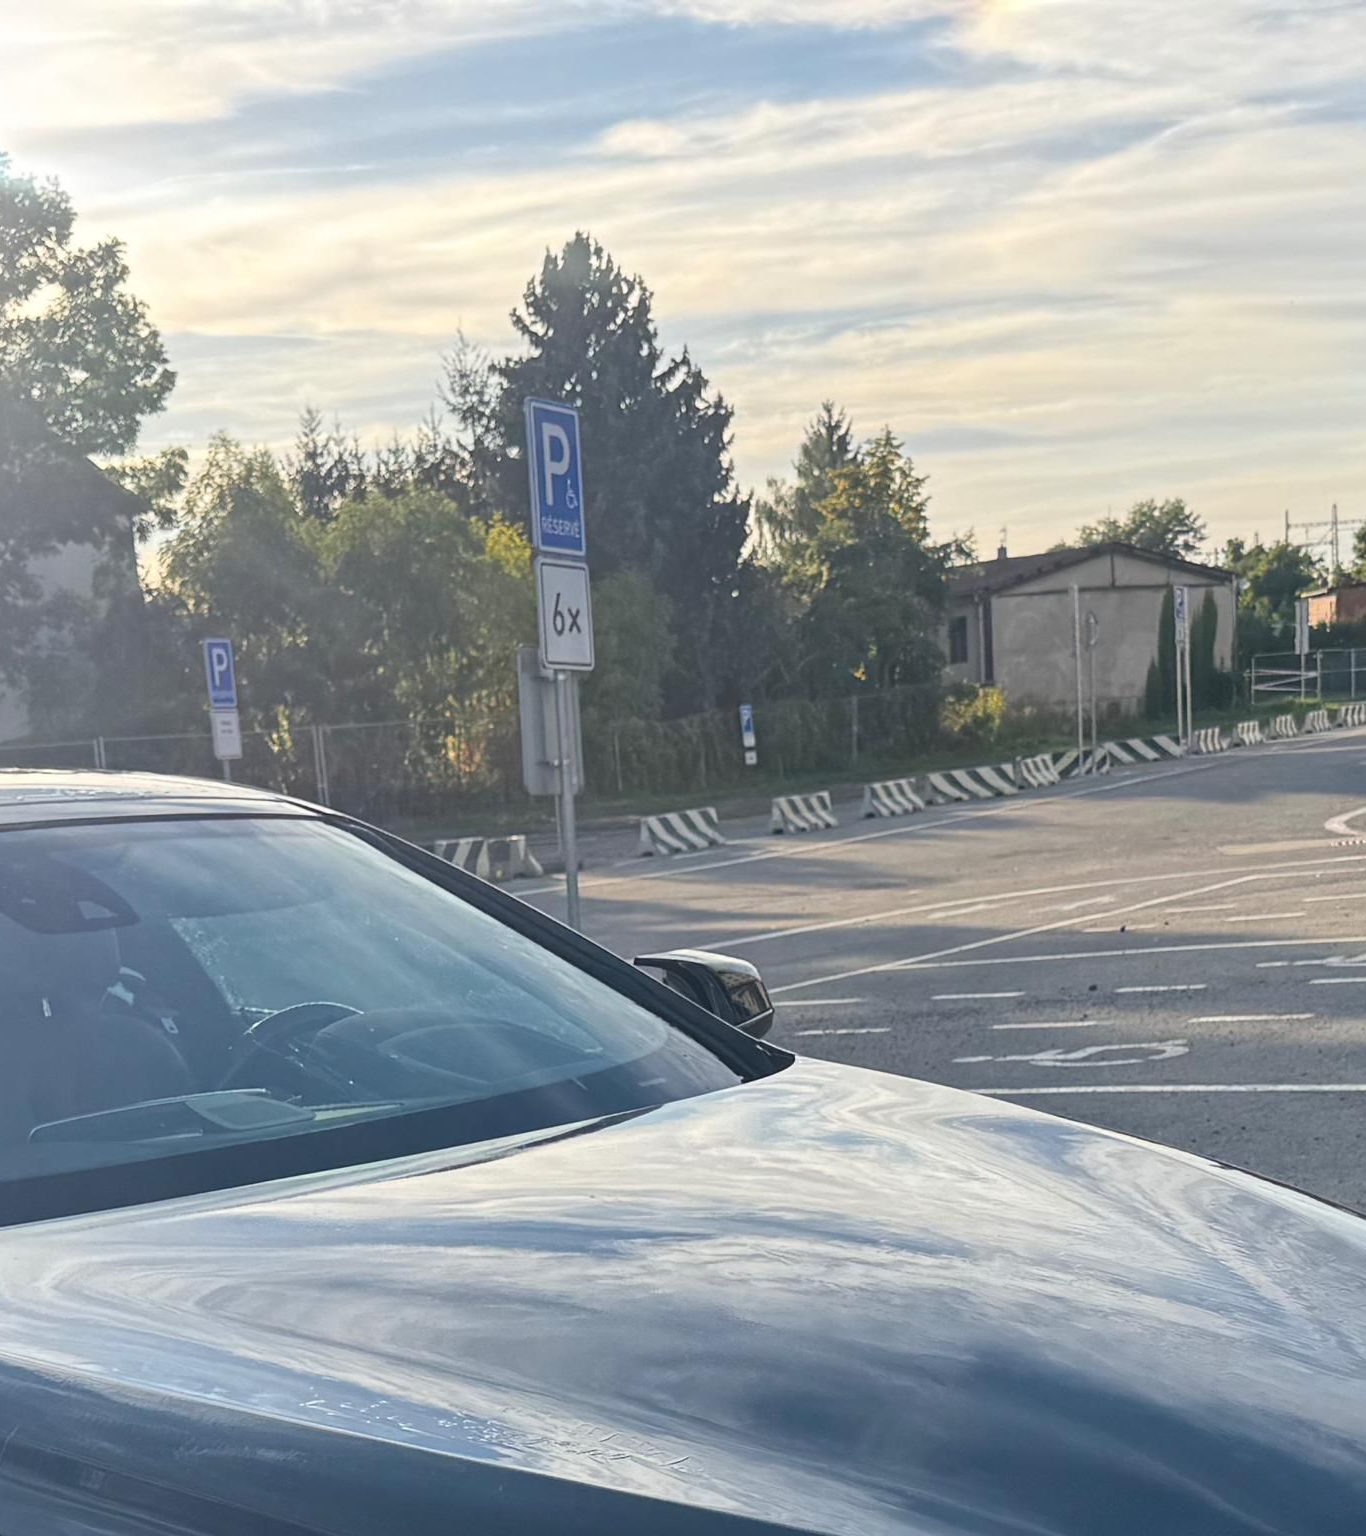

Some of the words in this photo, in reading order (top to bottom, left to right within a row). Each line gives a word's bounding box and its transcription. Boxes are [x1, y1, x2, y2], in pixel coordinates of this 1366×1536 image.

[542, 422, 571, 506] P
[553, 592, 582, 636] 6x
[211, 647, 228, 687] P
